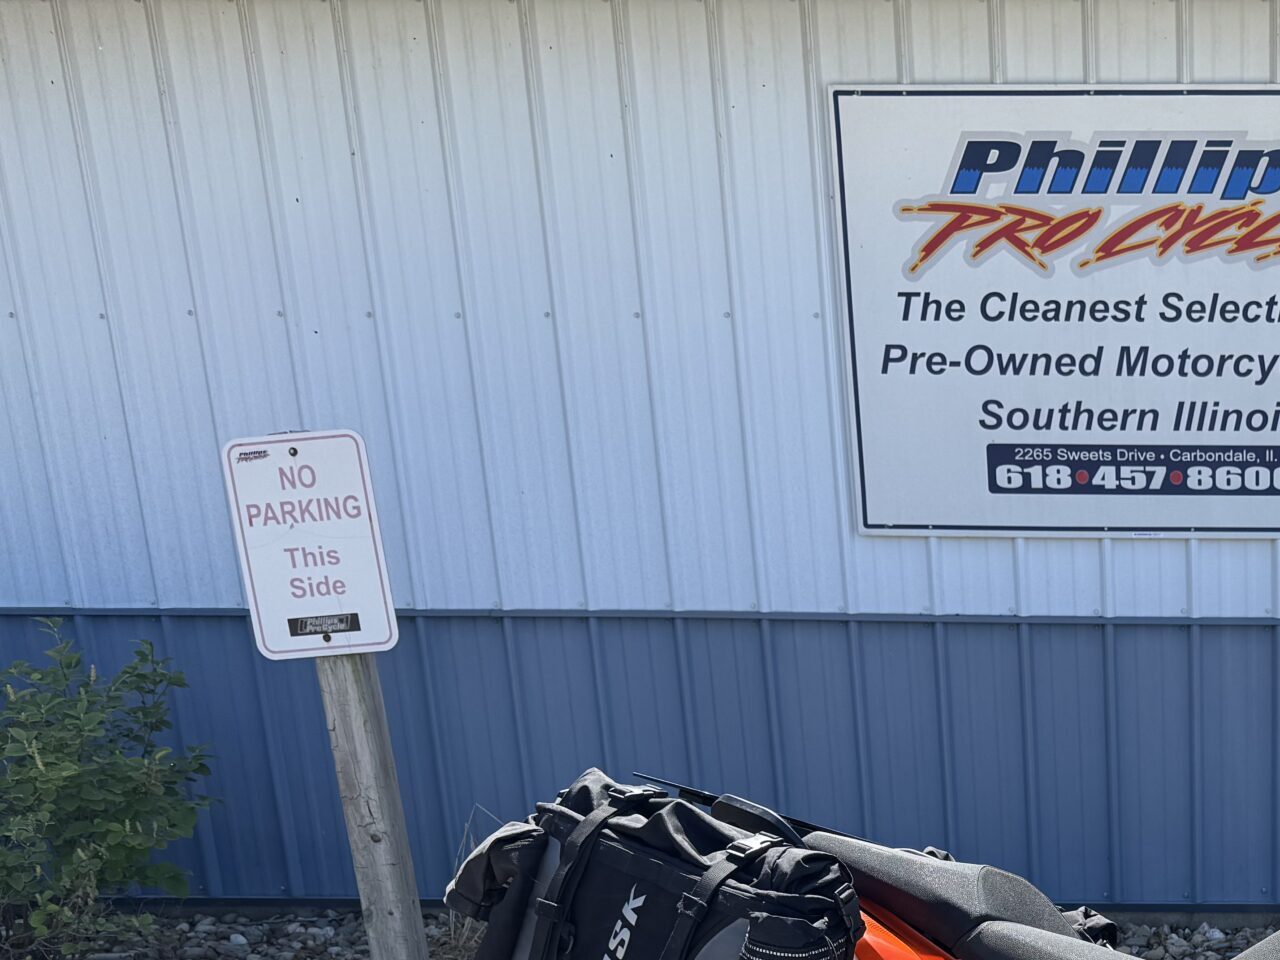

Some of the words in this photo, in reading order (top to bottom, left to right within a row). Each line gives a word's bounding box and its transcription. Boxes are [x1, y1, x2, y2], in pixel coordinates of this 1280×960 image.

[902, 201, 1104, 274] PRO
[897, 292, 967, 323] The
[979, 292, 1147, 323] Cleanest
[880, 343, 1104, 377] Pre-Owned
[978, 399, 1160, 432] Southern
[1014, 448, 1053, 462] 2265
[1056, 448, 1113, 462] Sweets
[1116, 448, 1156, 462] Drive
[1168, 449, 1261, 464] Carbondale,
[277, 463, 317, 491] NO
[245, 494, 362, 528] PARKING
[283, 545, 341, 570] This
[289, 575, 347, 600] Side
